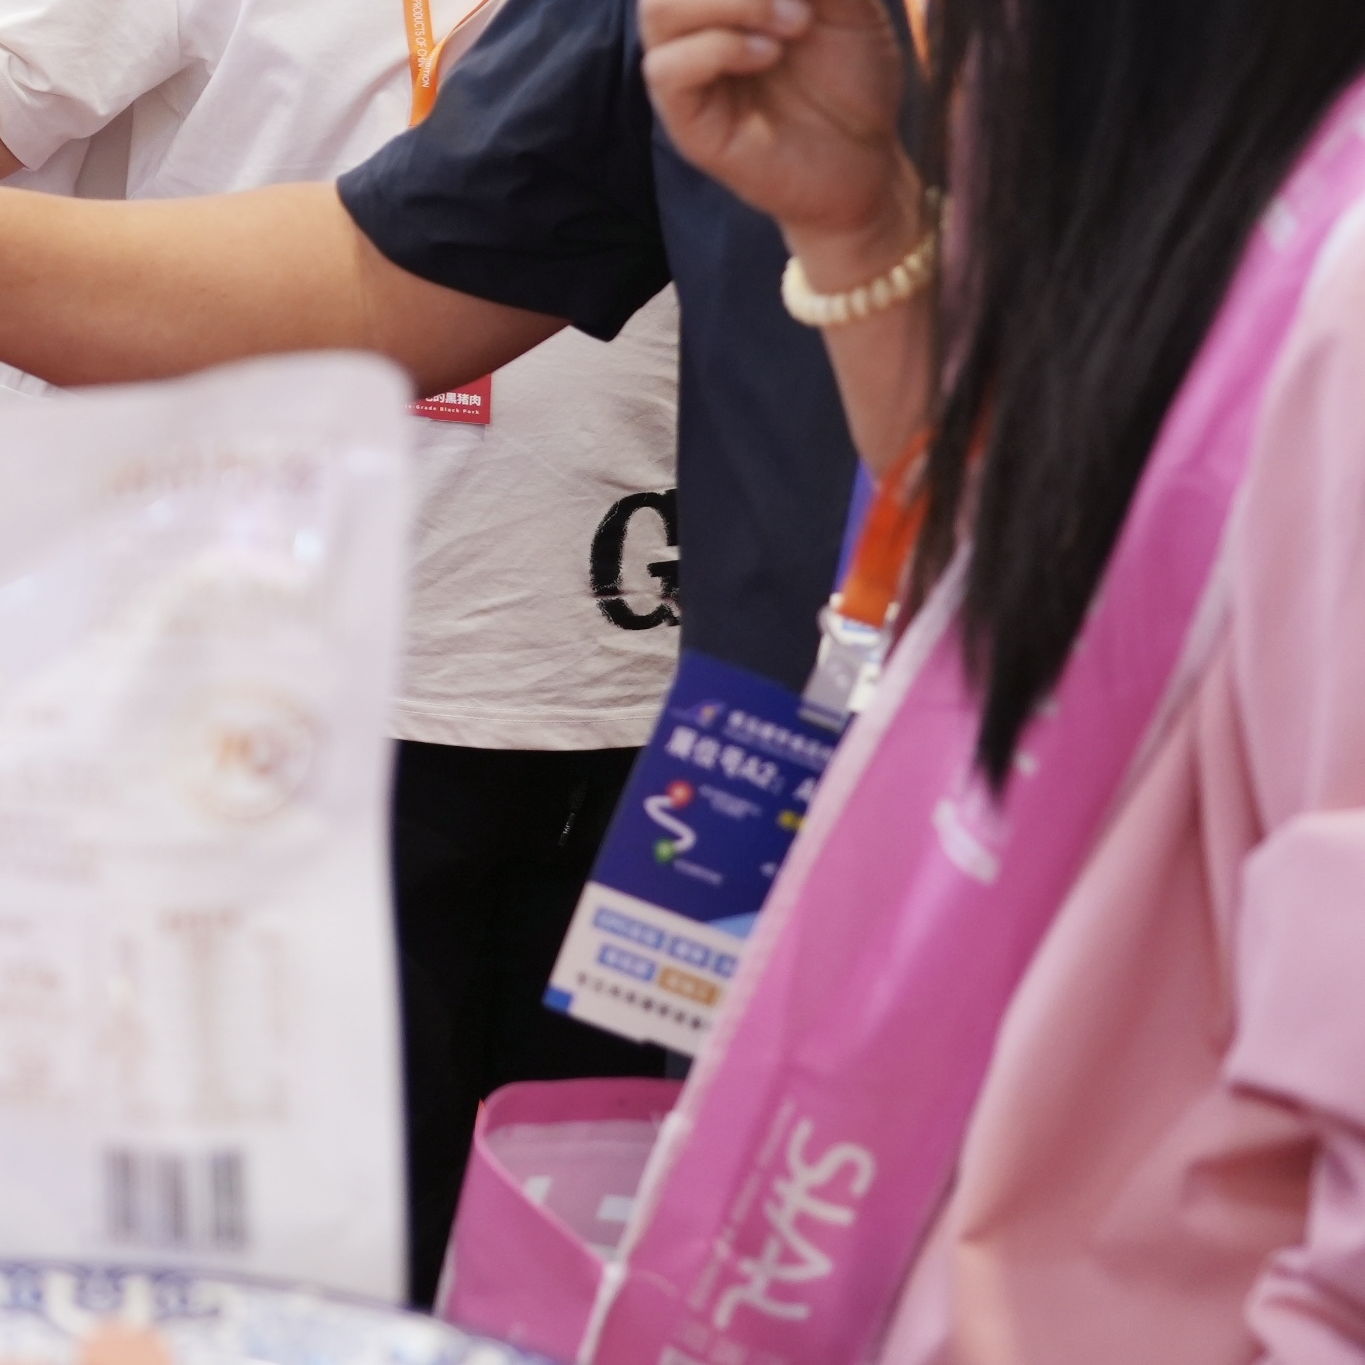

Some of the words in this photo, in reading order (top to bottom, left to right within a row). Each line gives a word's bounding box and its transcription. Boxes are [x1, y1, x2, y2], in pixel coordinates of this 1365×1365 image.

[412, 0, 425, 36] PRODUCTS
[426, 392, 482, 406] 的黑猪肉
[715, 1118, 875, 1328] SIAL
